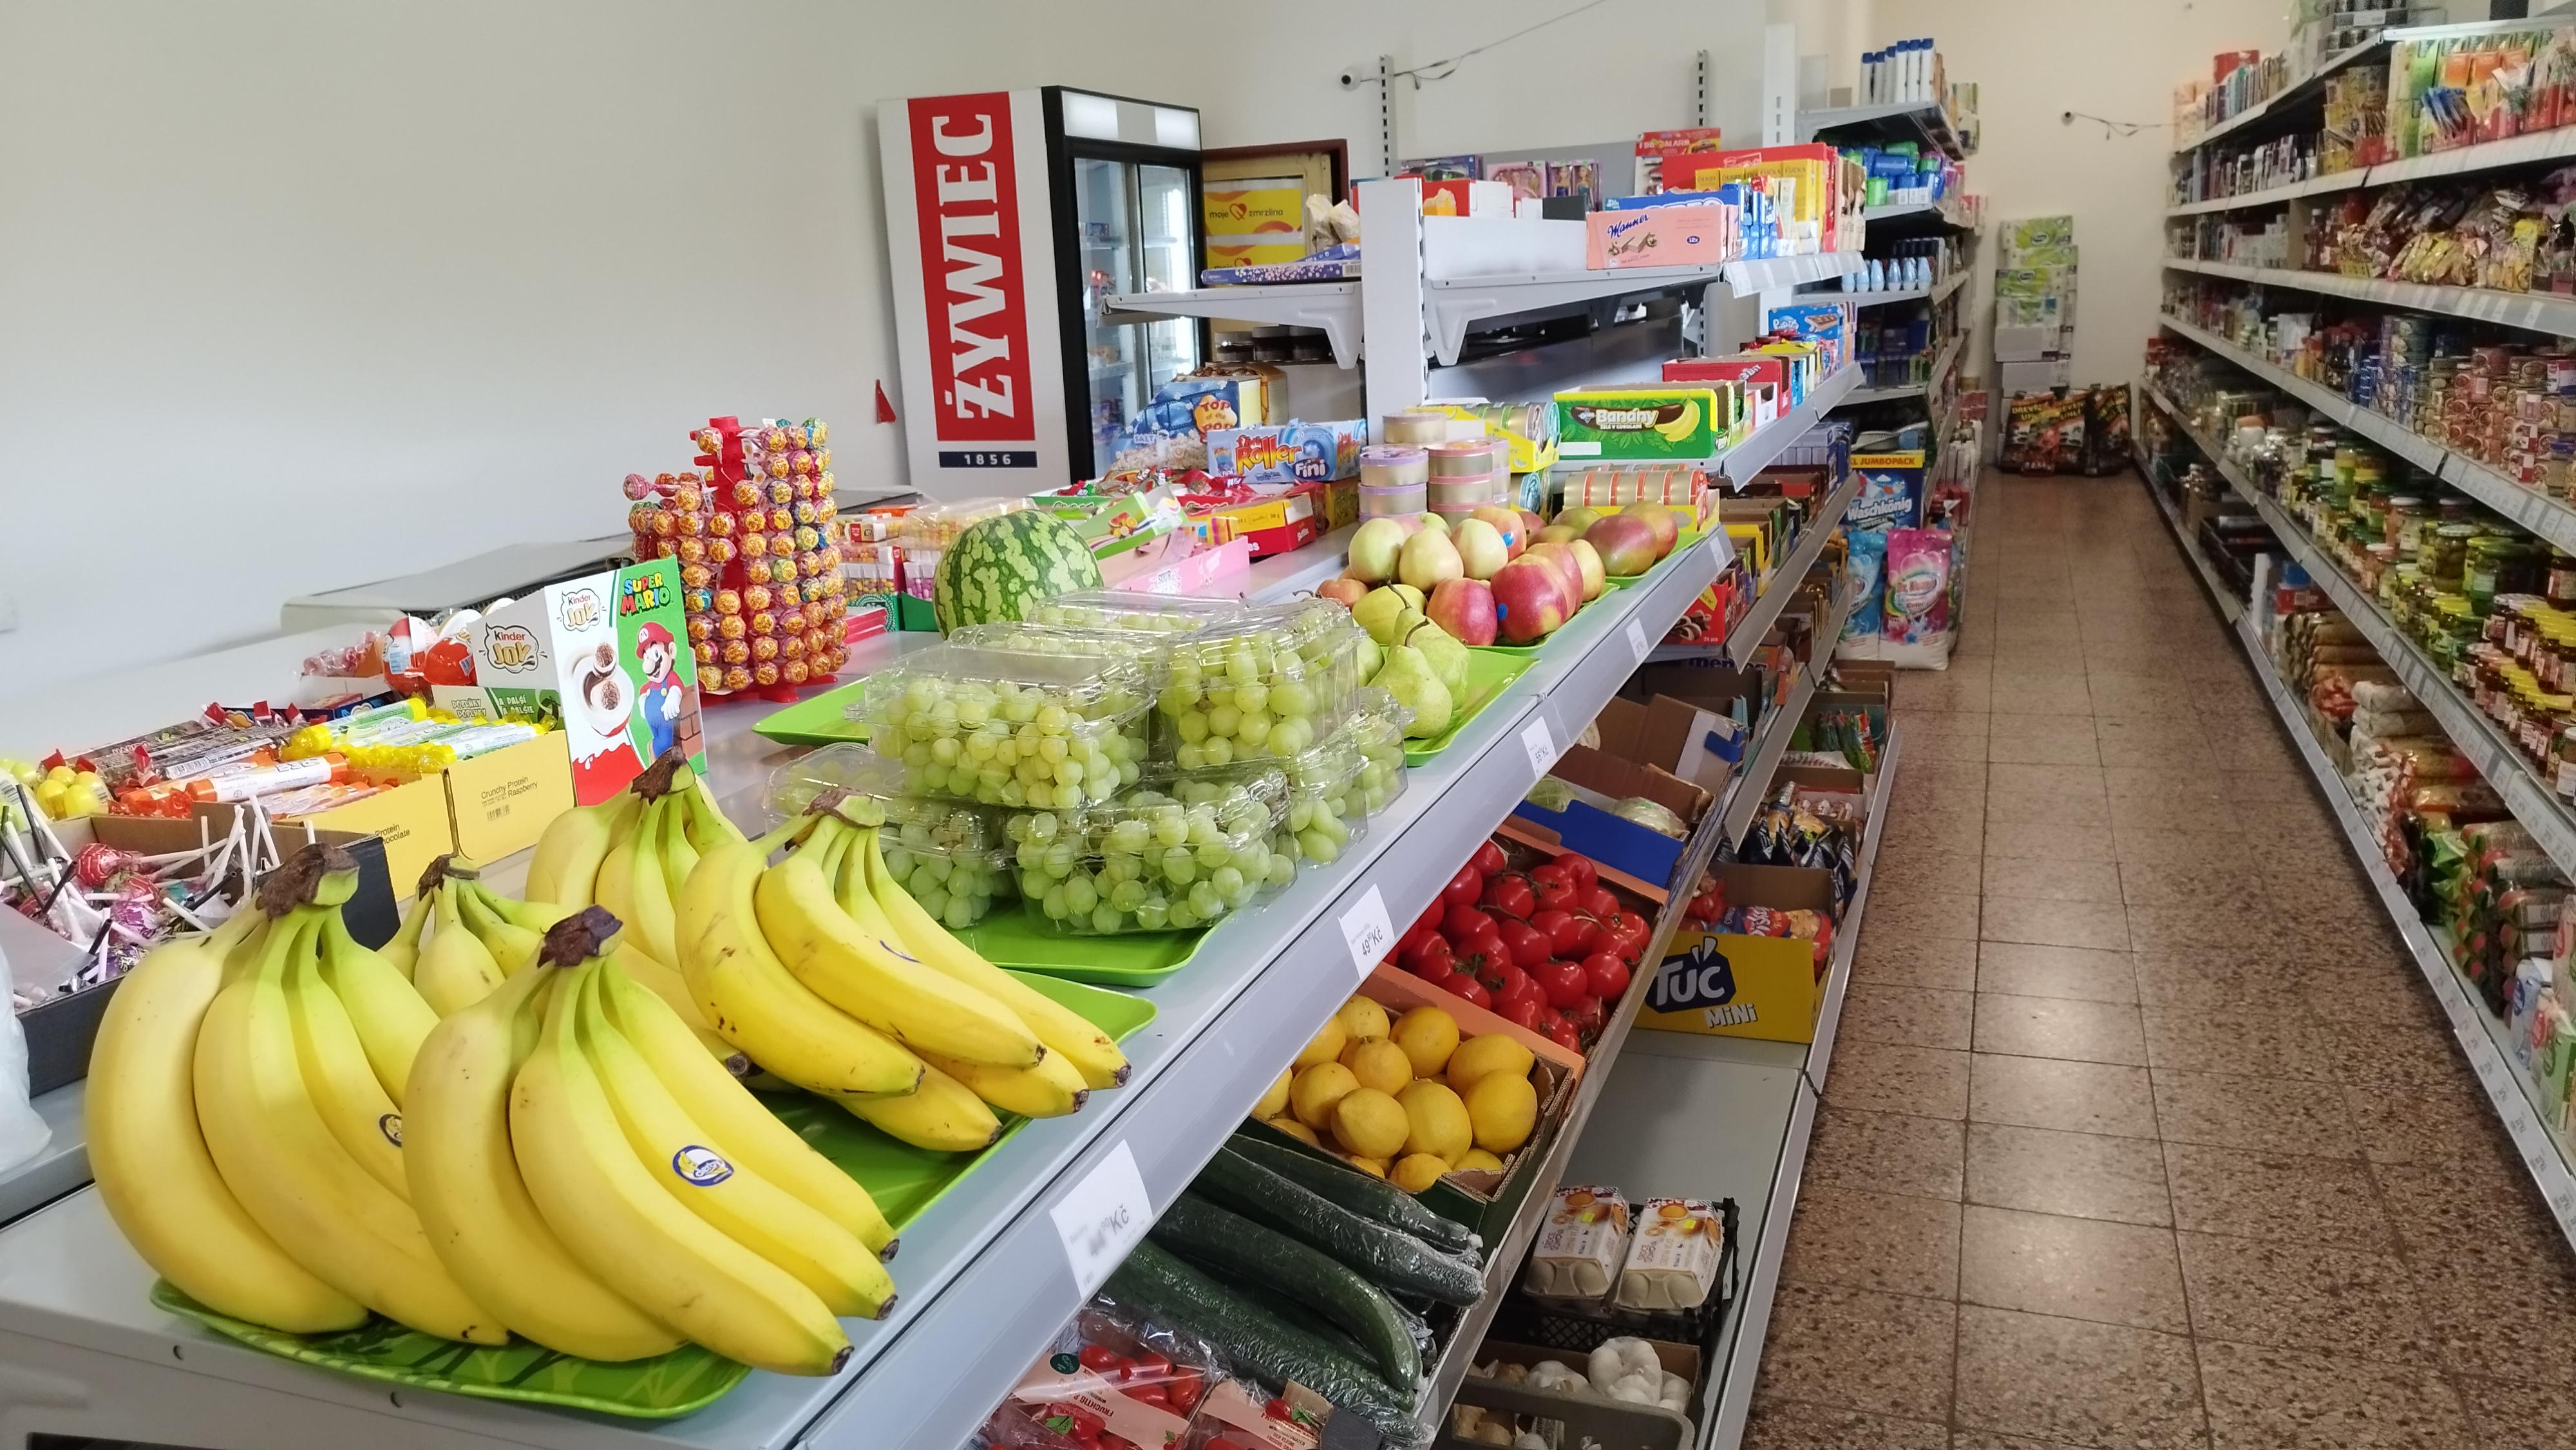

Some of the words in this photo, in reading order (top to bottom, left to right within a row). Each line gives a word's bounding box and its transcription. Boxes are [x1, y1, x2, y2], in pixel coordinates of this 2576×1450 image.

[1209, 211, 1229, 220] moje
[1249, 209, 1283, 217] zmrzlina
[1607, 214, 1650, 238] Manner
[932, 113, 1015, 420] ŻYWIEC
[1200, 400, 1231, 411] TOP
[1596, 408, 1659, 428] Banány
[1134, 434, 1155, 443] SALT
[963, 453, 1012, 466] 1856
[1235, 435, 1302, 475] Roller
[1295, 459, 1326, 478] Fini
[1848, 496, 1913, 521] Waschkönig
[623, 572, 664, 595] SUPER
[567, 594, 591, 606] Kinder
[620, 586, 672, 617] MARIO
[566, 603, 596, 627] JOY
[494, 630, 526, 641] Kinder
[492, 641, 531, 666] JOY
[481, 785, 506, 799] Crunchy
[508, 781, 538, 798] Raspberry
[507, 777, 528, 789] Protein
[1653, 959, 1725, 1007] TUC
[1109, 1203, 1130, 1236] Kč
[1079, 1395, 1114, 1417] FRUCHTIG
